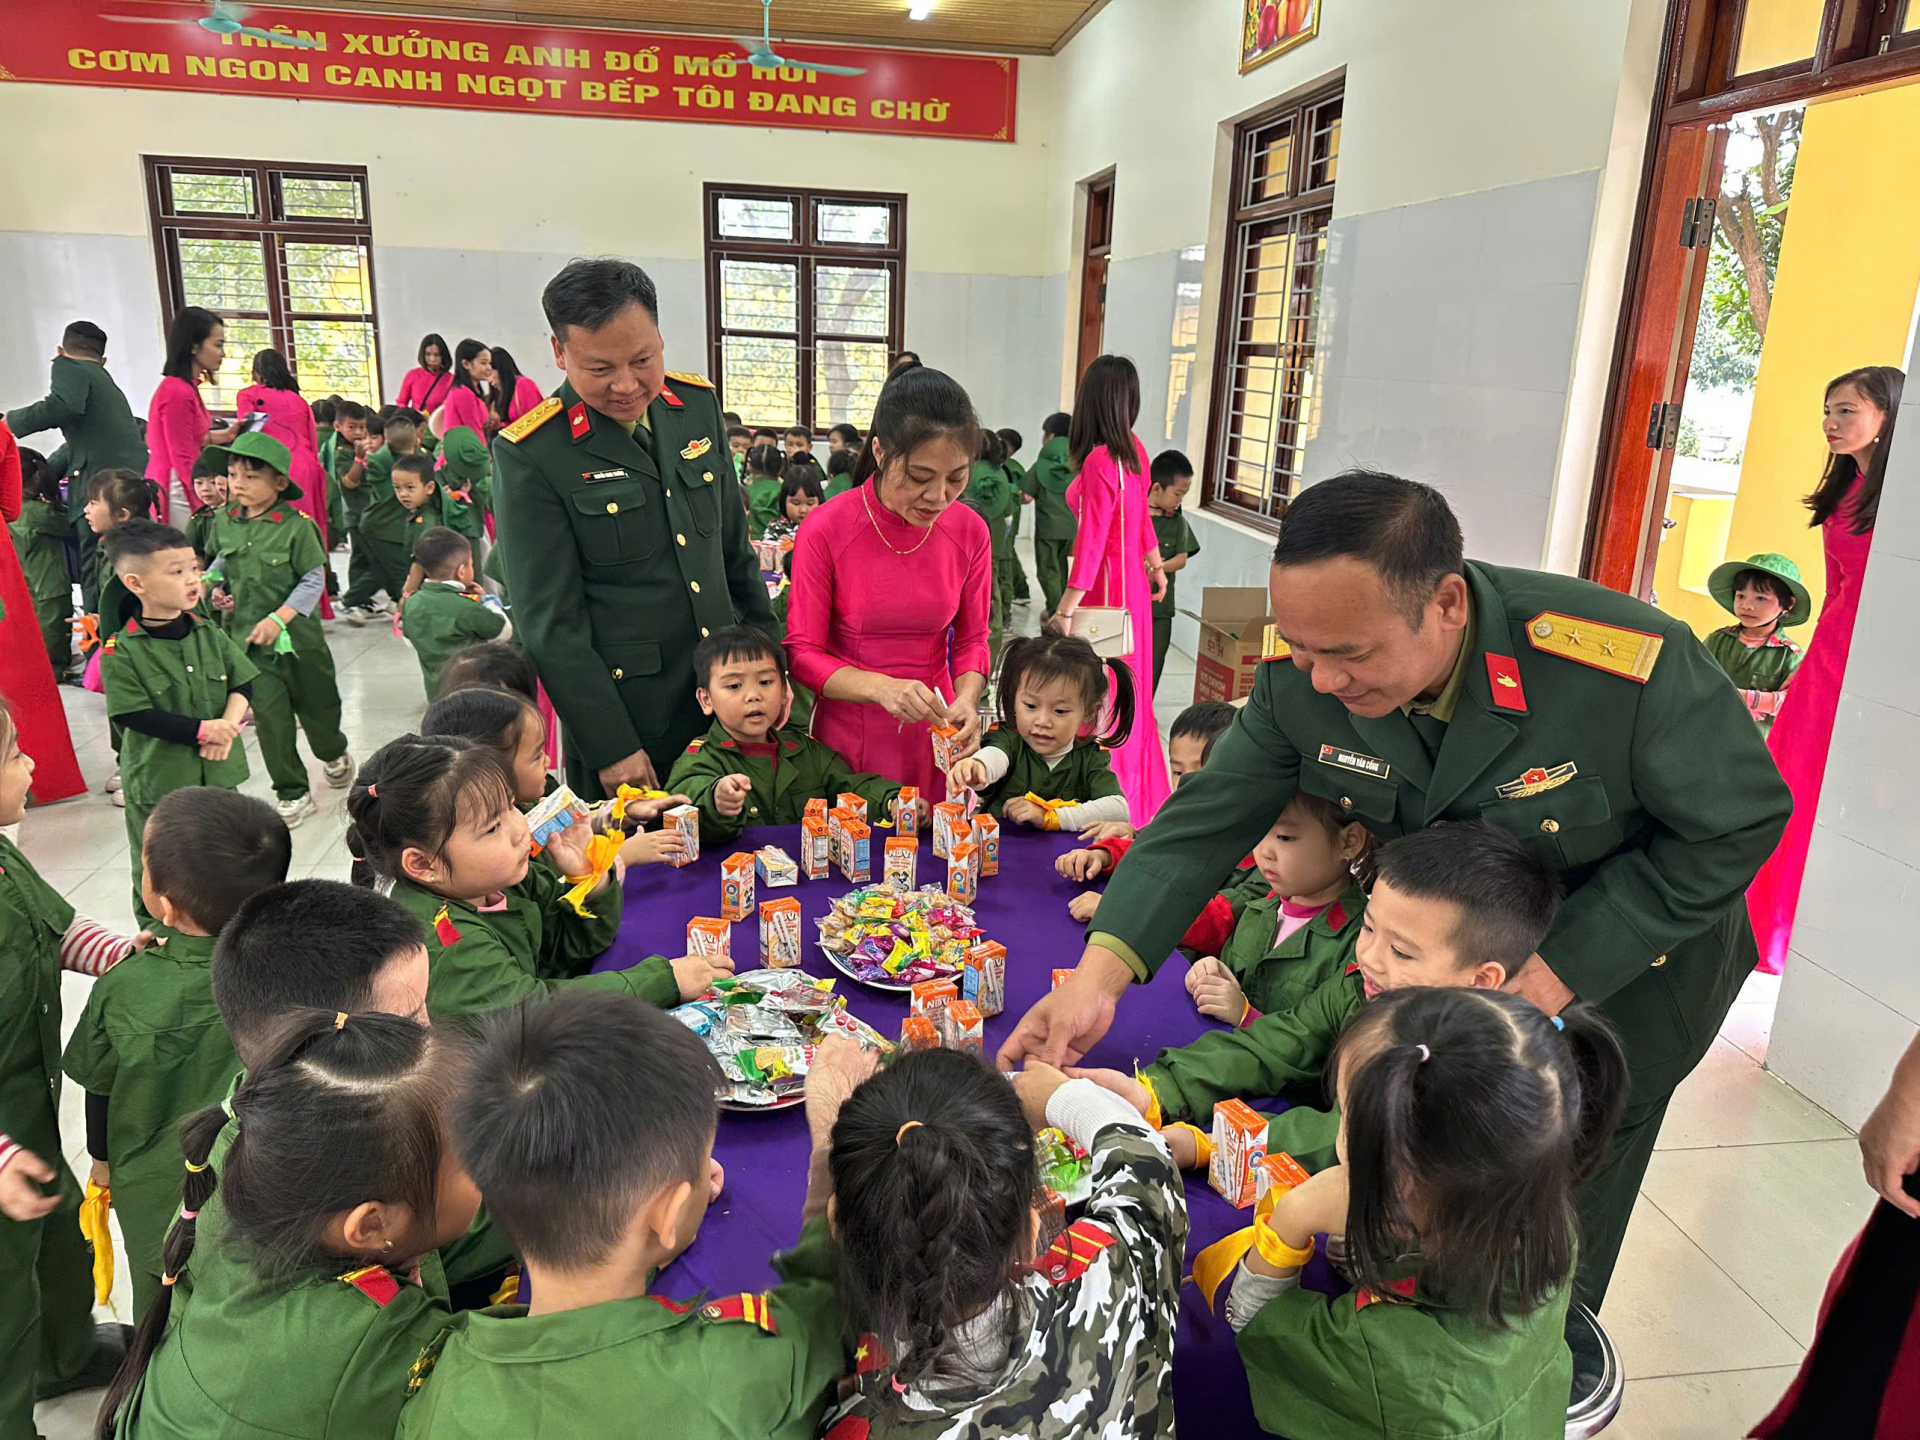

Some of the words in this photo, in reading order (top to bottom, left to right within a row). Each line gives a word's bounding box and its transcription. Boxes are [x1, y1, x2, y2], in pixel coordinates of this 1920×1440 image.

[343, 28, 489, 63] XƯỞNG
[504, 45, 590, 69] ANH
[604, 46, 660, 73] ĐỔ
[673, 52, 737, 78] MỒ
[68, 48, 170, 74] CƠM
[186, 55, 309, 83] NGON
[325, 65, 442, 91] CANH
[457, 74, 567, 102] NGỌT
[581, 77, 659, 104] BẾP
[673, 85, 735, 109] TÔI
[748, 91, 856, 117] ĐANG
[870, 99, 950, 122] CHỜ
